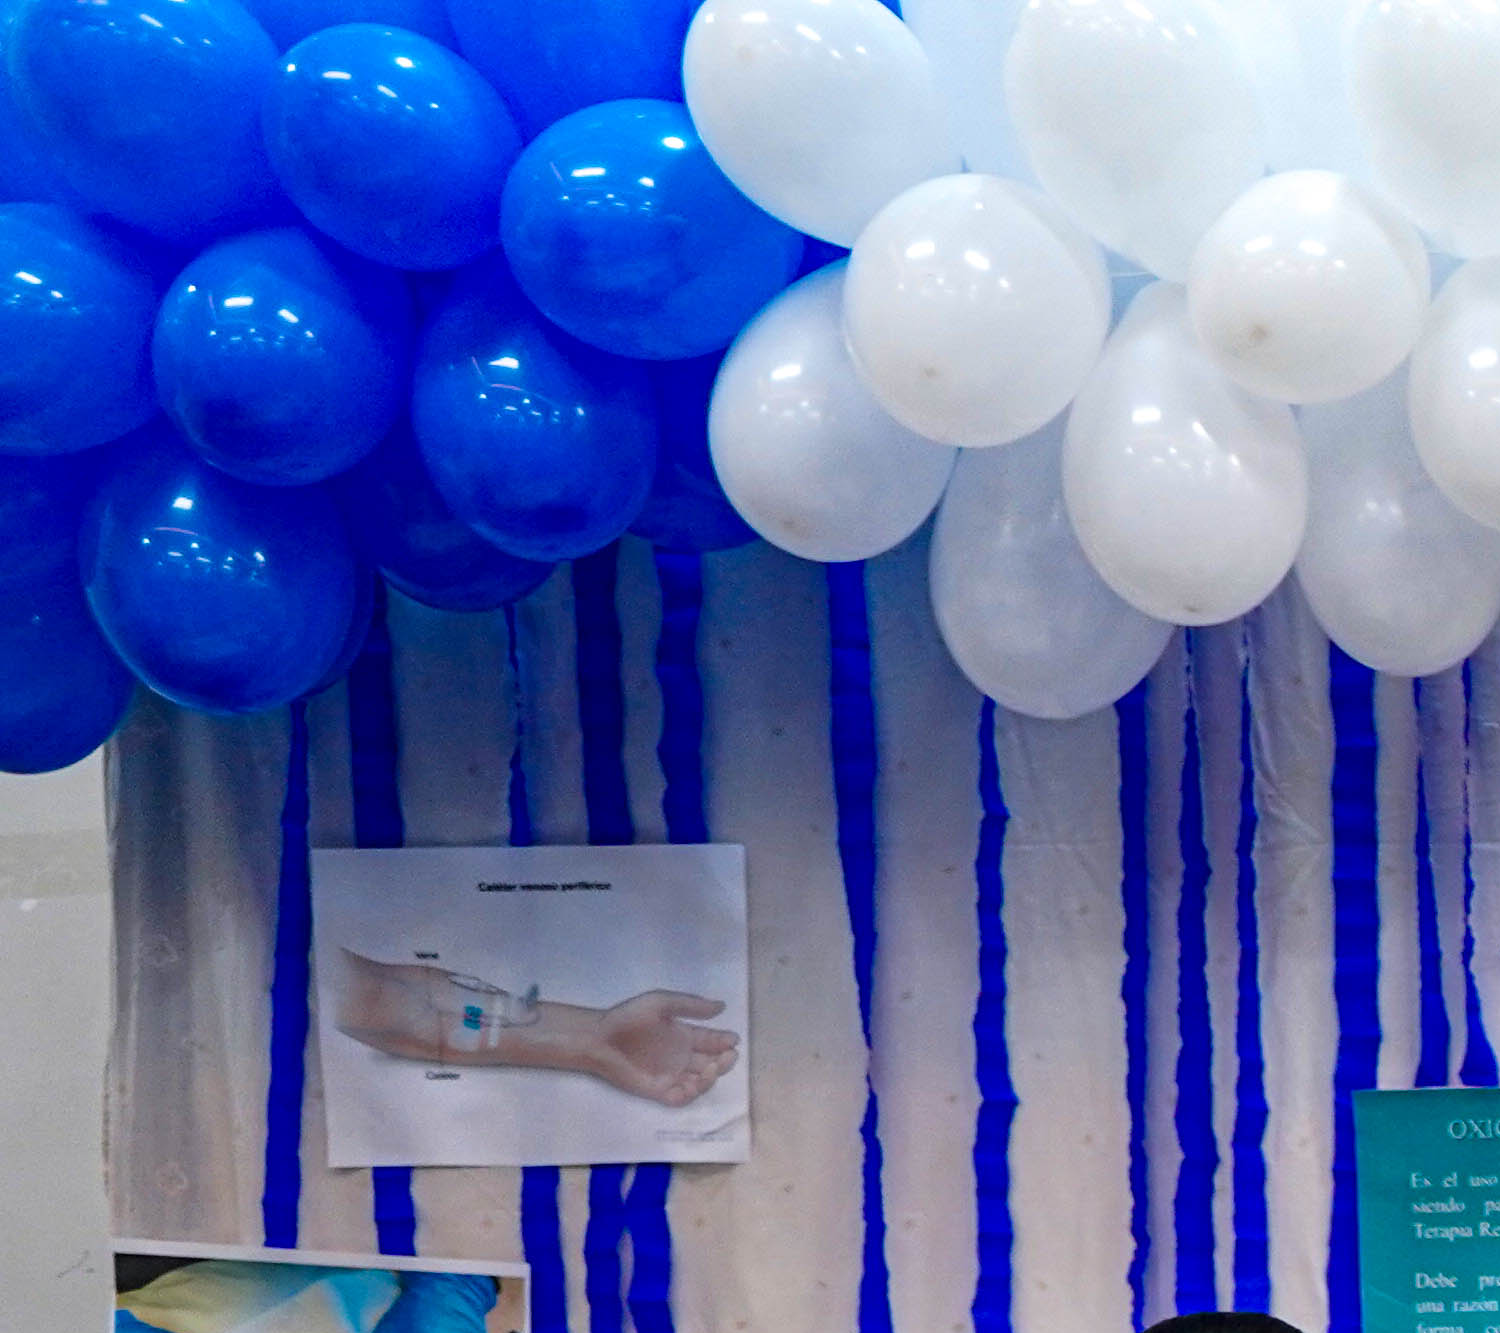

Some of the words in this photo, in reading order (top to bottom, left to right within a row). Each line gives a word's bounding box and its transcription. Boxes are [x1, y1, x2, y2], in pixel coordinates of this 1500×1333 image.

[1442, 1171, 1458, 1188] el
[1414, 1222, 1473, 1242] Terapia
[1415, 1272, 1458, 1288] Debe
[1416, 1301, 1445, 1313] una
